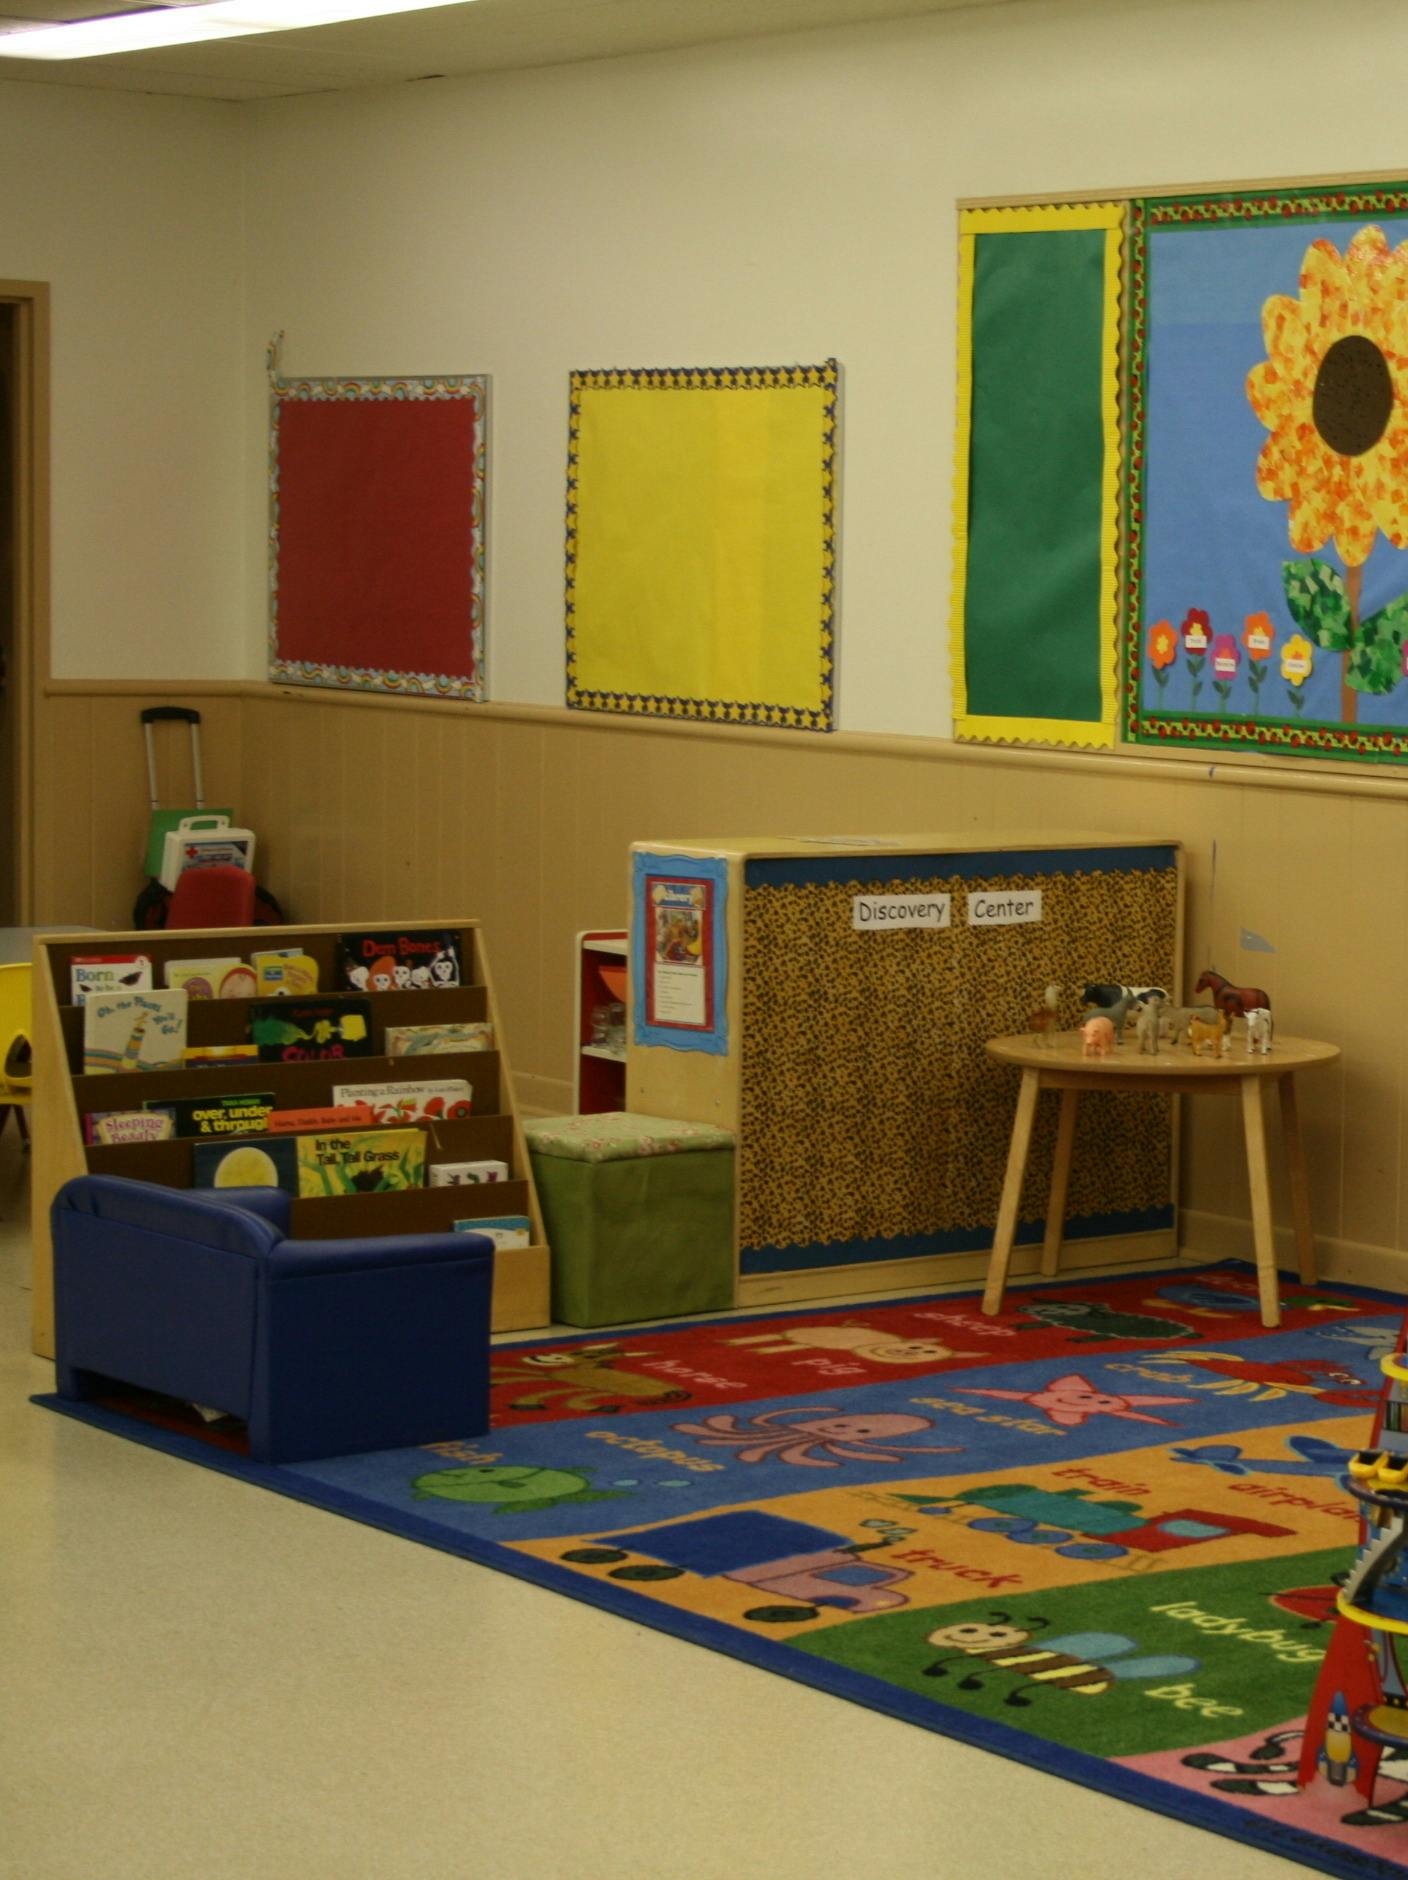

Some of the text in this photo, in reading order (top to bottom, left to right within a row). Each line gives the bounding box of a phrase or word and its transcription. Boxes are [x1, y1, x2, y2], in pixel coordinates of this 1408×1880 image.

[858, 897, 1035, 922] Discovery Center
[362, 935, 441, 957] Dem Bones
[76, 968, 114, 982] Born
[340, 1087, 378, 1098] Planting
[387, 1084, 425, 1095] Rainbow
[229, 1105, 273, 1118] under
[106, 1117, 165, 1131] Sleeping
[200, 1120, 213, 1133] &
[316, 1138, 351, 1151] In the
[341, 1150, 361, 1164] Tall
[364, 1150, 400, 1162] Grass
[914, 1310, 1017, 1337] sheep
[642, 1359, 748, 1390] horse
[793, 1357, 868, 1379] pig
[1106, 1361, 1194, 1387] crab
[975, 1414, 1069, 1437] star
[584, 1430, 726, 1474] octopus
[1052, 1465, 1154, 1499] train
[890, 1546, 1025, 1590] truck
[1149, 1600, 1327, 1664] ladybug
[1144, 1682, 1245, 1719] bee
